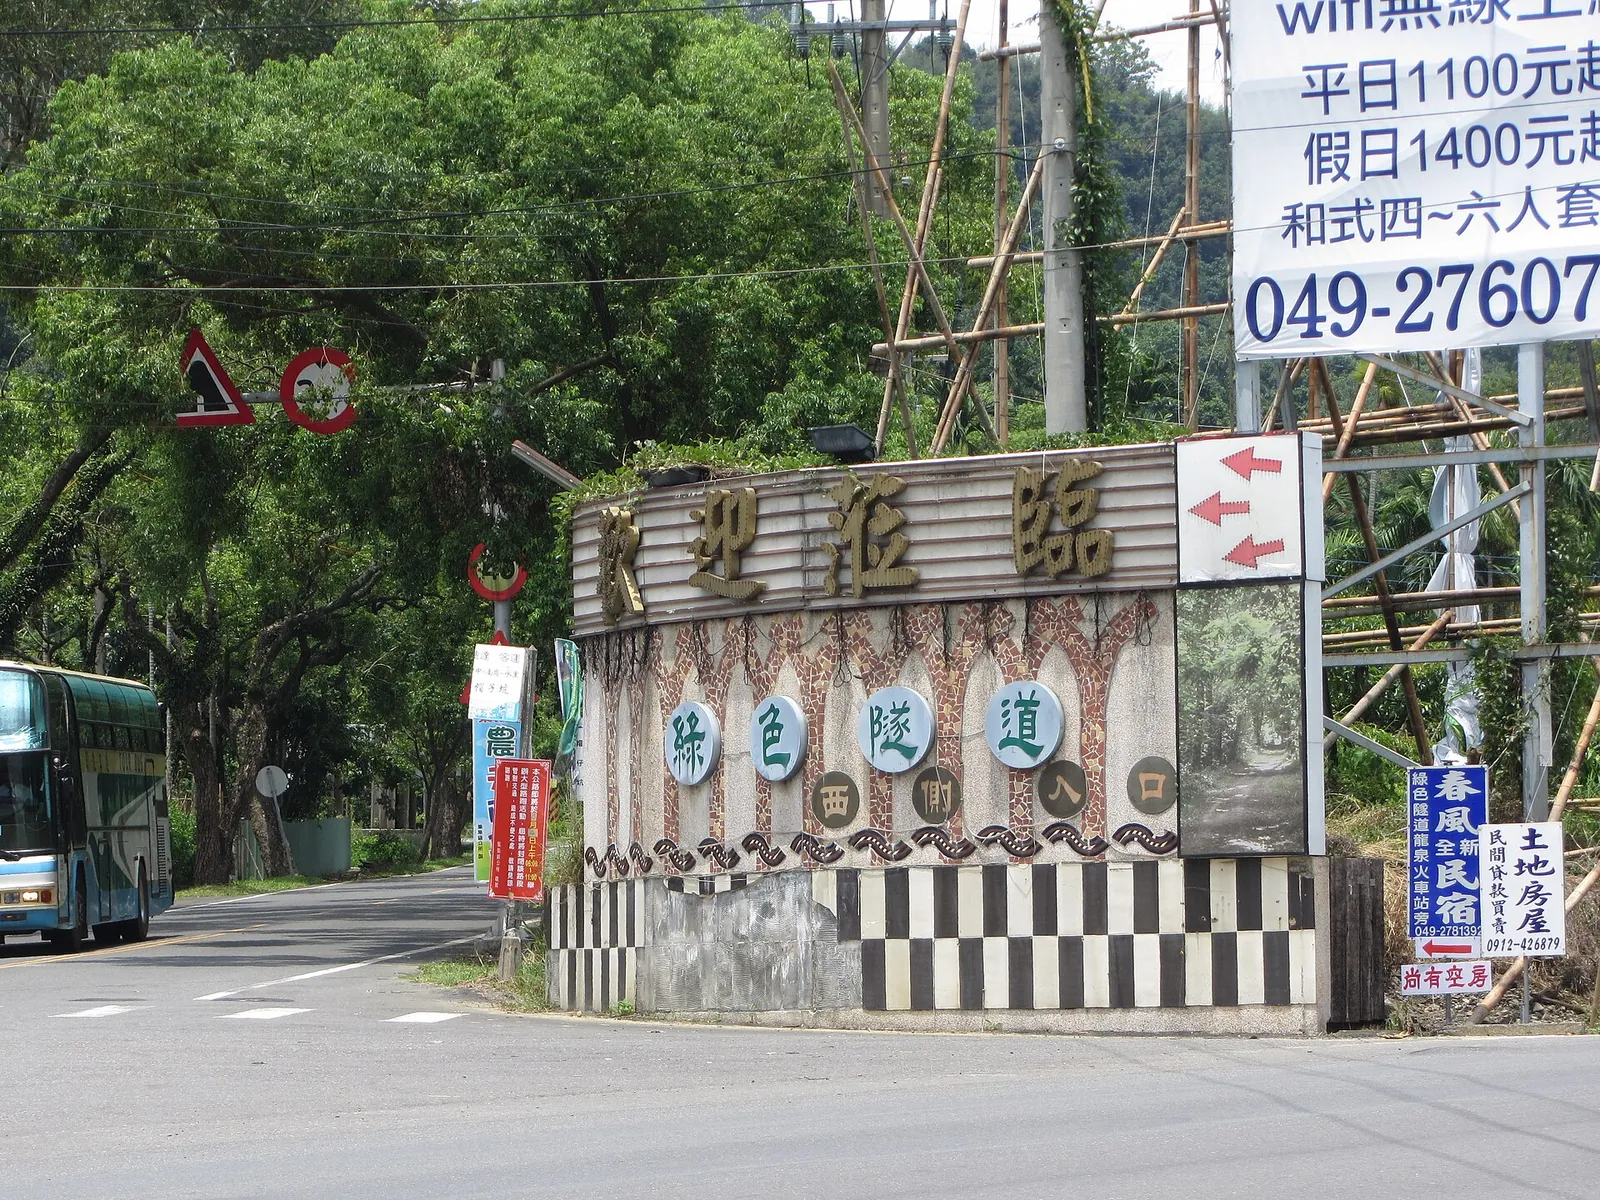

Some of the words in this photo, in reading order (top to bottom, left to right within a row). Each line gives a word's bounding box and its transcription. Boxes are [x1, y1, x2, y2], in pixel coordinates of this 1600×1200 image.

[1246, 254, 1600, 343] 049-27607
[672, 689, 1044, 776] 綠色隧道
[820, 771, 1166, 819] 西側入口
[1433, 770, 1481, 836] 春風
[1411, 771, 1430, 926] 綠色隧道龍泉火車站旁
[1488, 829, 1509, 935] 民間貸款買賣
[1513, 827, 1556, 935] 土地房屋
[1435, 858, 1480, 926] 民宿
[1402, 965, 1489, 991] 尚有空房
[1486, 936, 1561, 952] 0912-426879
